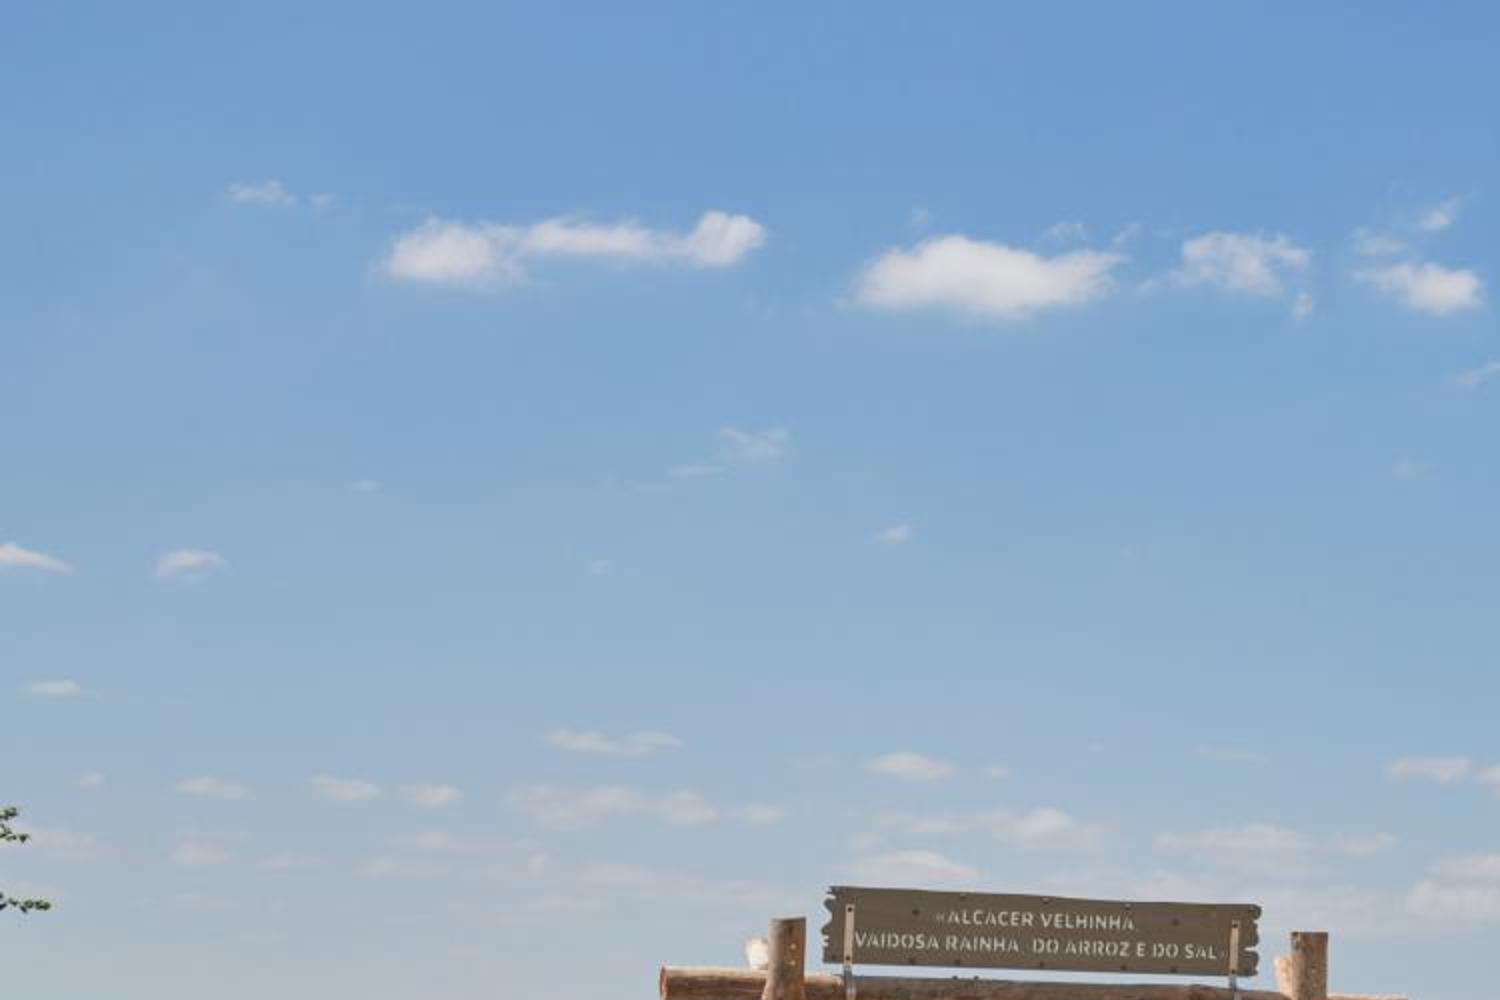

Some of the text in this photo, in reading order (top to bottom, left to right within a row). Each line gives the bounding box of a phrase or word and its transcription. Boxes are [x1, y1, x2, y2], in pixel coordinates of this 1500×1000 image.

[855, 931, 940, 950] VAIDOSA
[1033, 938, 1059, 955] DO
[1065, 939, 1131, 958] ARROZ
[1136, 943, 1146, 957] E
[1153, 943, 1179, 959] DO
